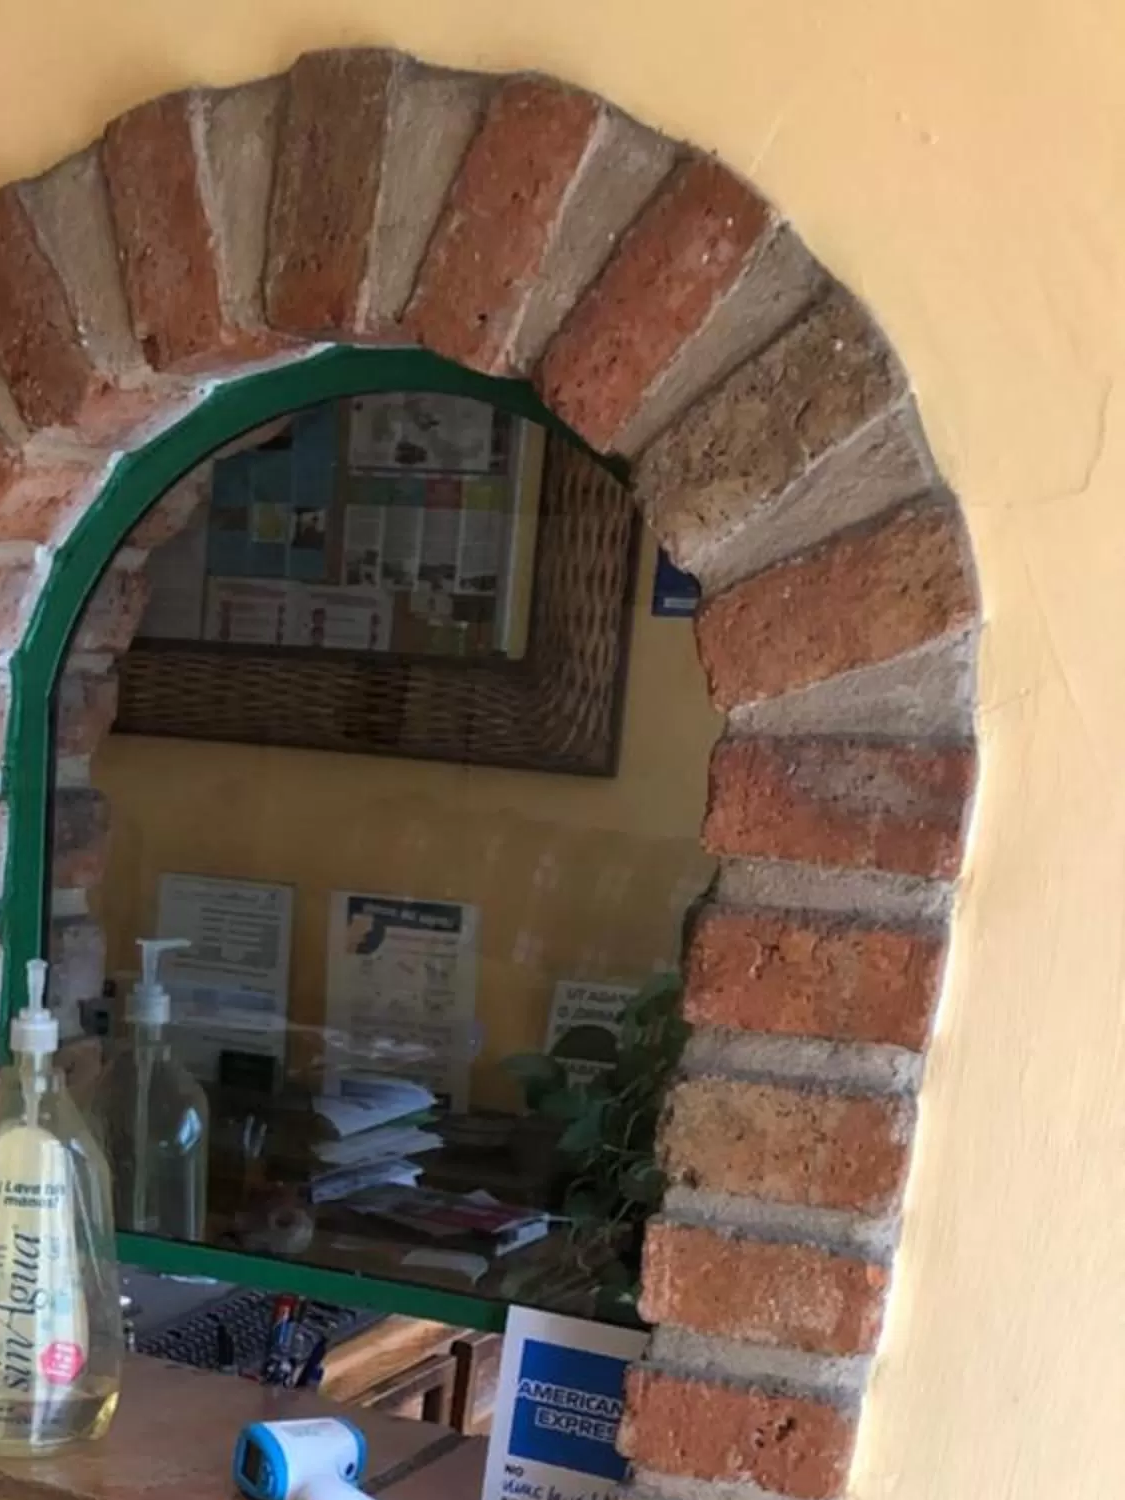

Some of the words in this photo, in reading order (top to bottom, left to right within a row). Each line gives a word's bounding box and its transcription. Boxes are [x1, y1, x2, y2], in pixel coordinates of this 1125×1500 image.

[518, 1377, 624, 1419] AMERICAN
[535, 1407, 619, 1444] EXPRES
[504, 1463, 525, 1478] NO
